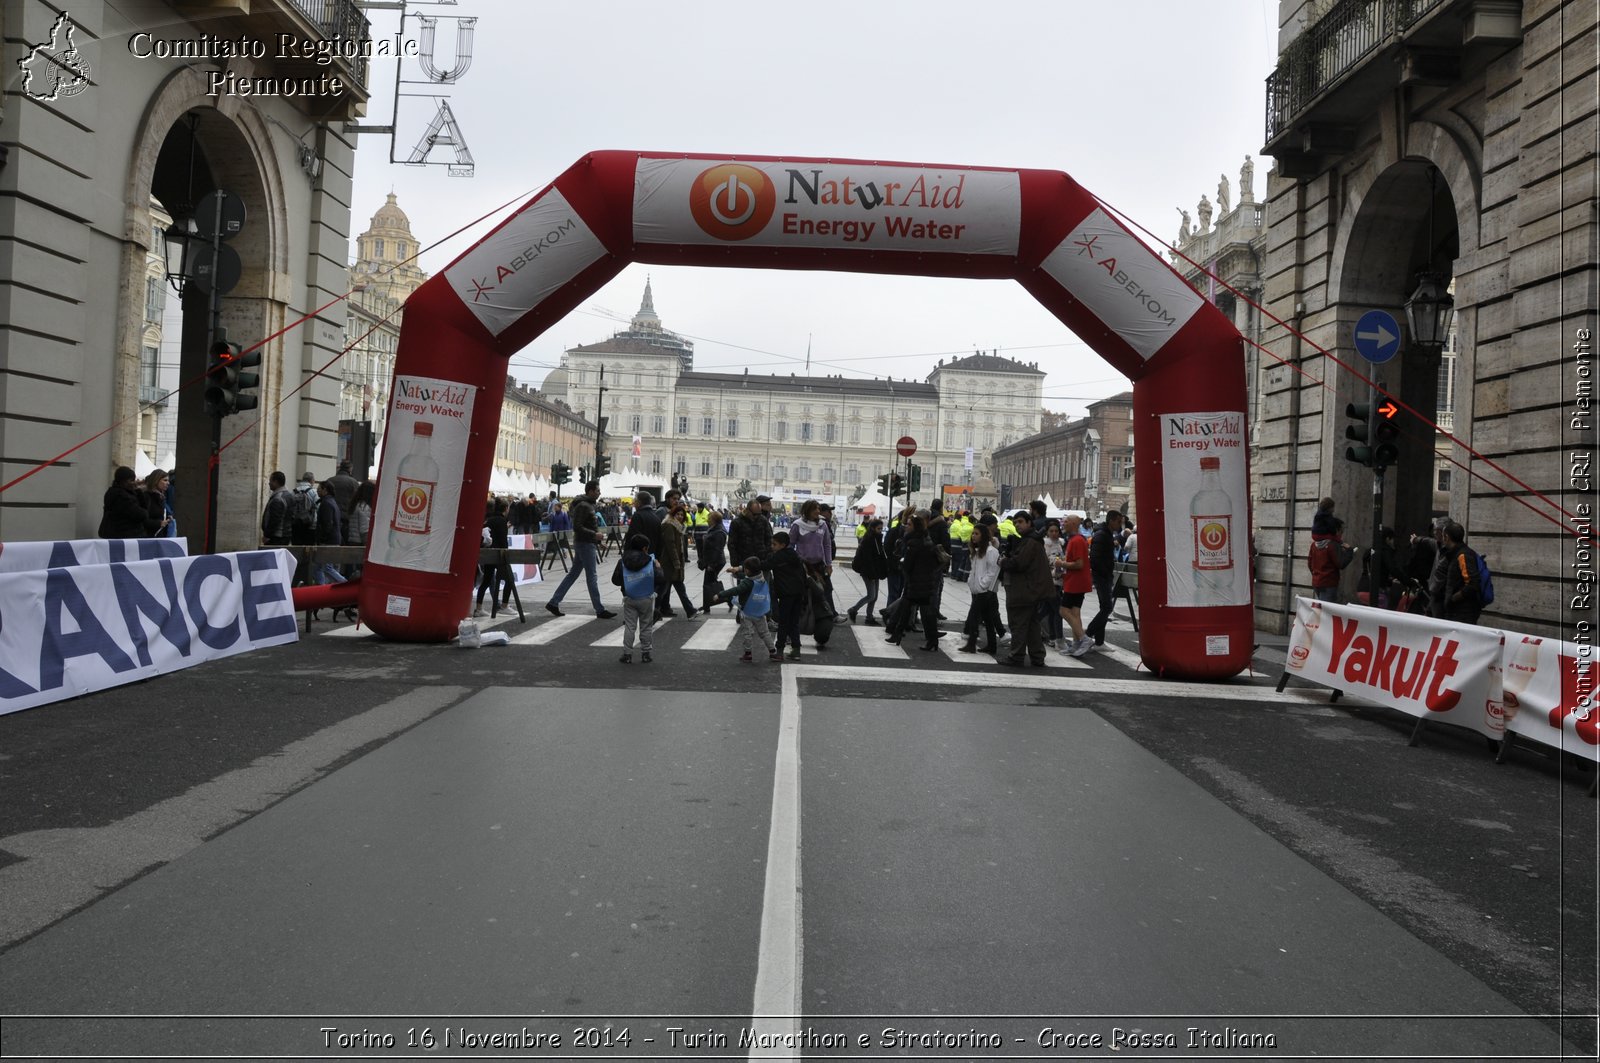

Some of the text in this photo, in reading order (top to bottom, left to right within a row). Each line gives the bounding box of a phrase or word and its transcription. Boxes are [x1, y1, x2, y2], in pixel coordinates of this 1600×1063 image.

[784, 169, 965, 210] NaturAid
[783, 213, 966, 242] Energy Water
[496, 218, 576, 284] ABEKOM
[1097, 257, 1176, 327] ABEKOM
[398, 380, 468, 405] NaturAid
[395, 400, 464, 418] Energy Water
[1169, 416, 1240, 435] NaturAid
[1170, 438, 1240, 450] Energy Water
[1327, 615, 1462, 712] Yakult
